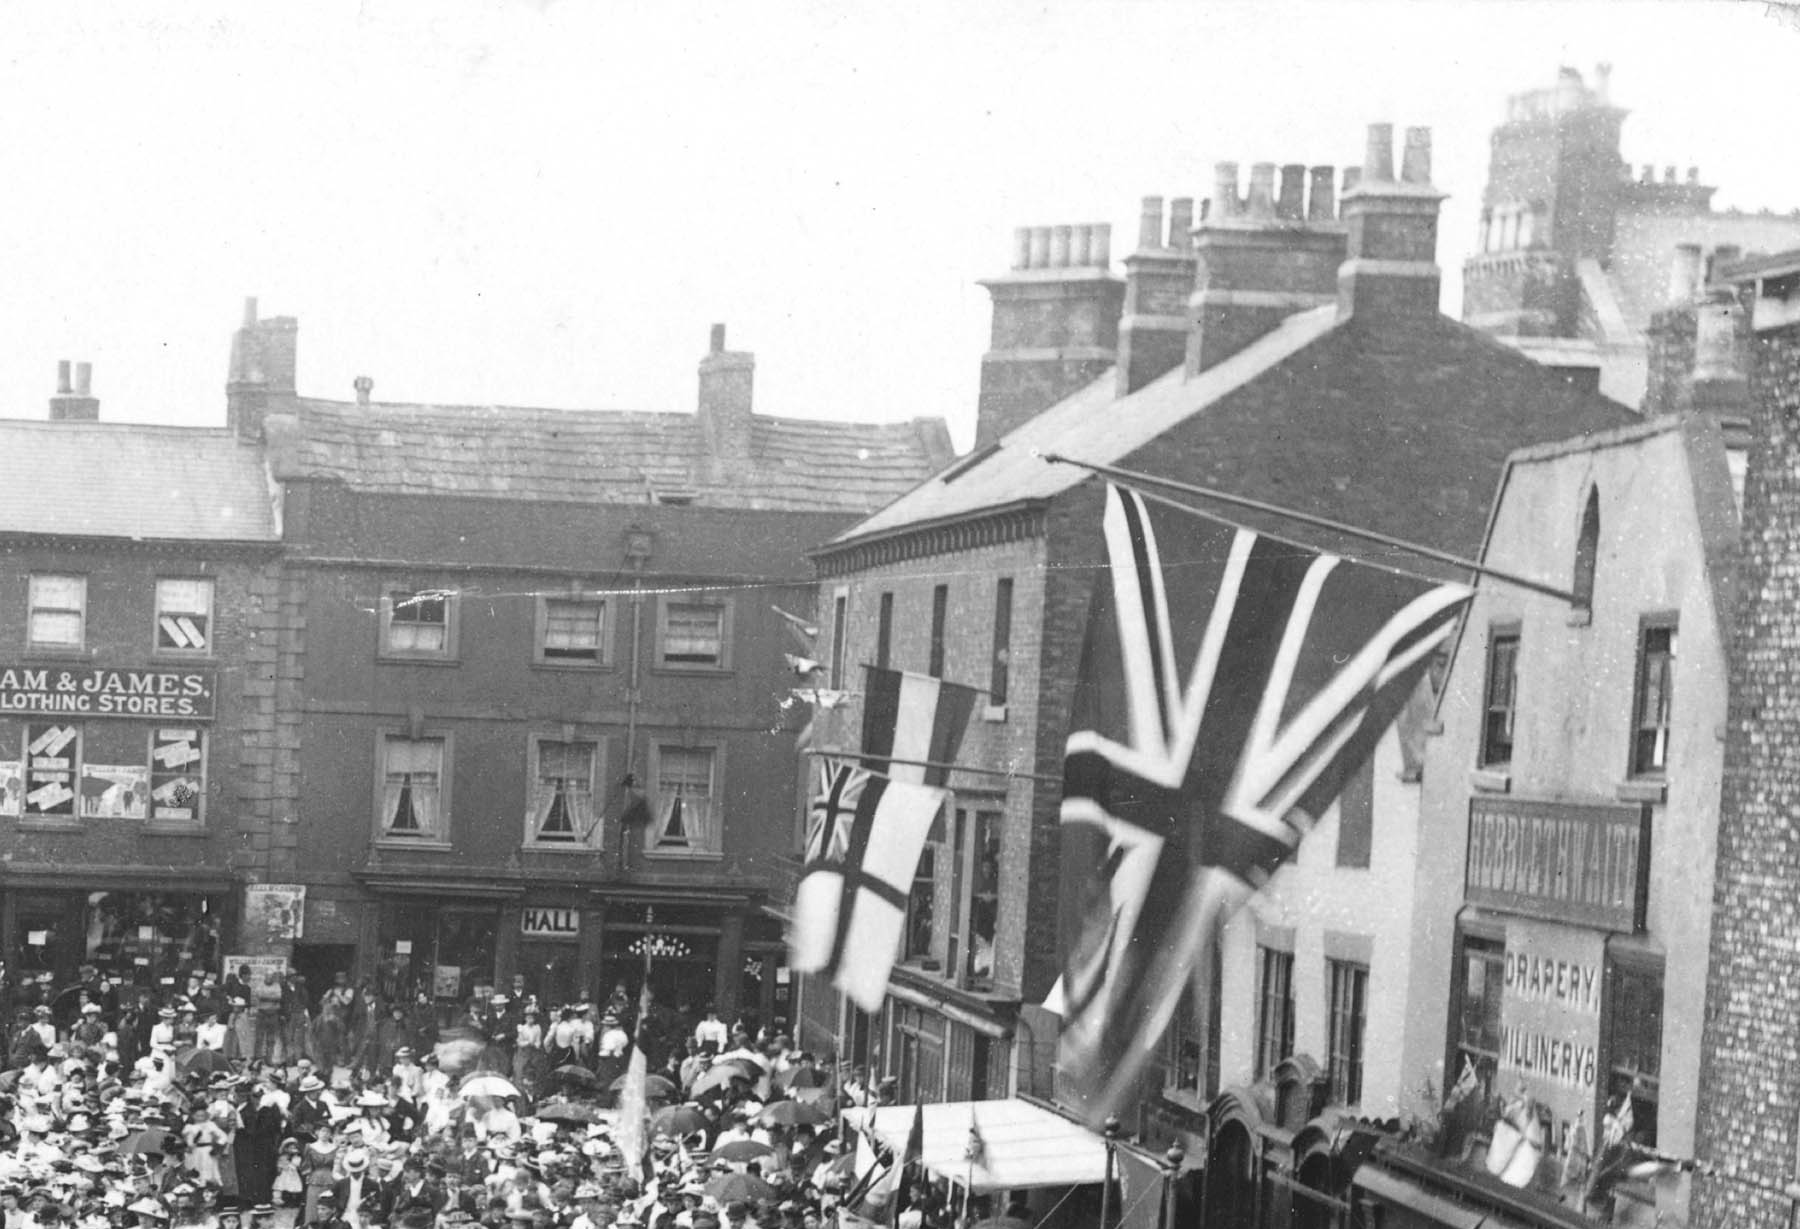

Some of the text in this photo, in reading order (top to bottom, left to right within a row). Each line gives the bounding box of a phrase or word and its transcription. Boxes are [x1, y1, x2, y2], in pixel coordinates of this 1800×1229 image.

[56, 672, 77, 692] &
[82, 671, 210, 698] JAMES.
[98, 694, 198, 715] STORES.
[524, 909, 577, 932] HALL
